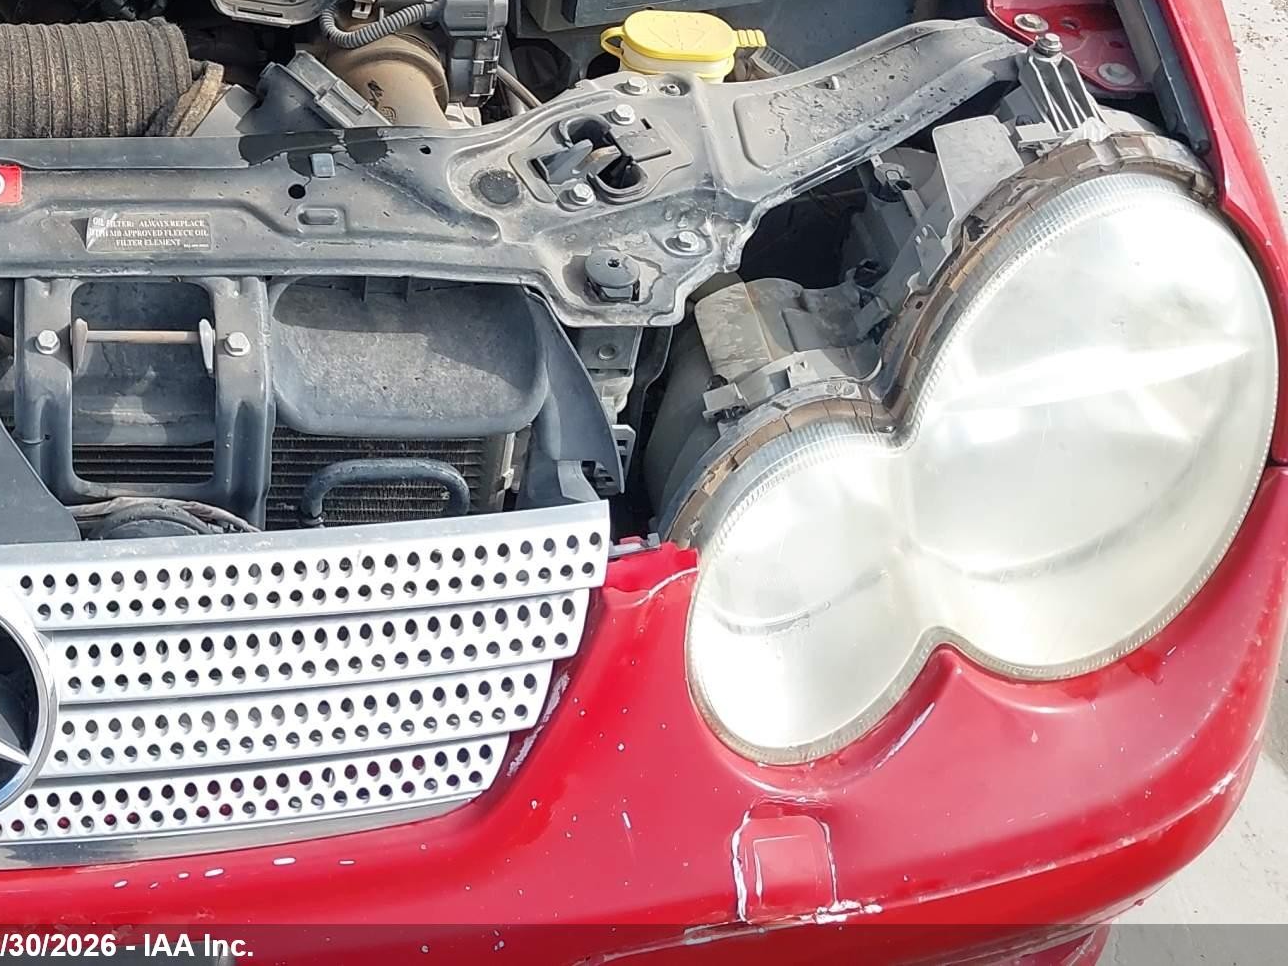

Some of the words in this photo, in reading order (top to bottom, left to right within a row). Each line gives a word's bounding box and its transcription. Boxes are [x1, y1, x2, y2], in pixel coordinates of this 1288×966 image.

[92, 216, 105, 227] OIL
[139, 219, 169, 228] ALWAYS
[170, 219, 205, 227] REPLACE
[123, 229, 164, 237] APPROVED
[194, 229, 209, 237] OIL
[115, 239, 143, 247] FILTER
[144, 238, 181, 247] ELEMENT
